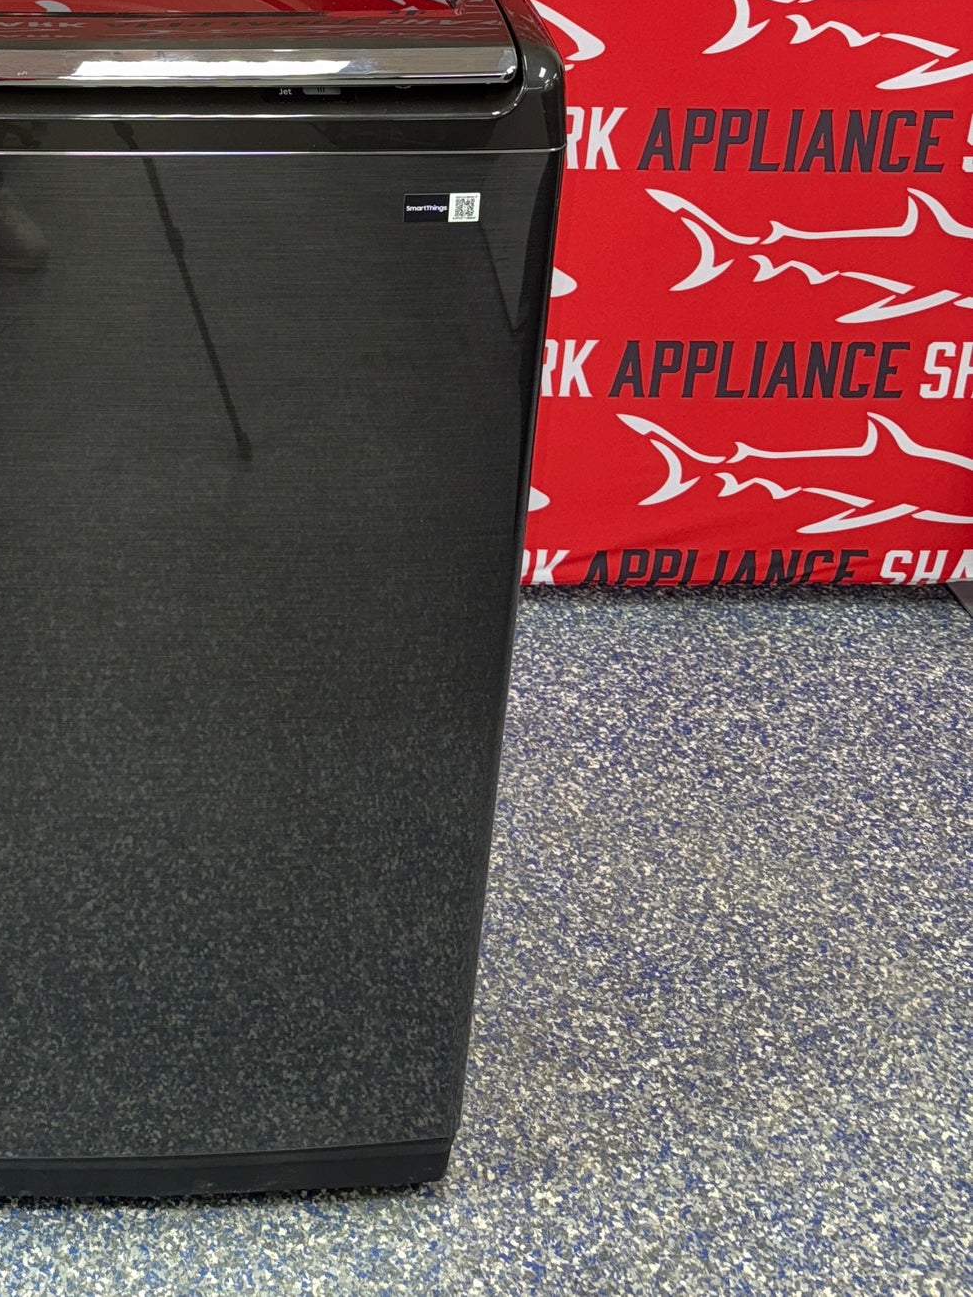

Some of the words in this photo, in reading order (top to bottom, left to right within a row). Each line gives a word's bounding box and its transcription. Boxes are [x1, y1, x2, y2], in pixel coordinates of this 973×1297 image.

[636, 107, 954, 173] APPLIANCE
[405, 204, 448, 213] SmartThings
[607, 341, 911, 399] APPLIANCE
